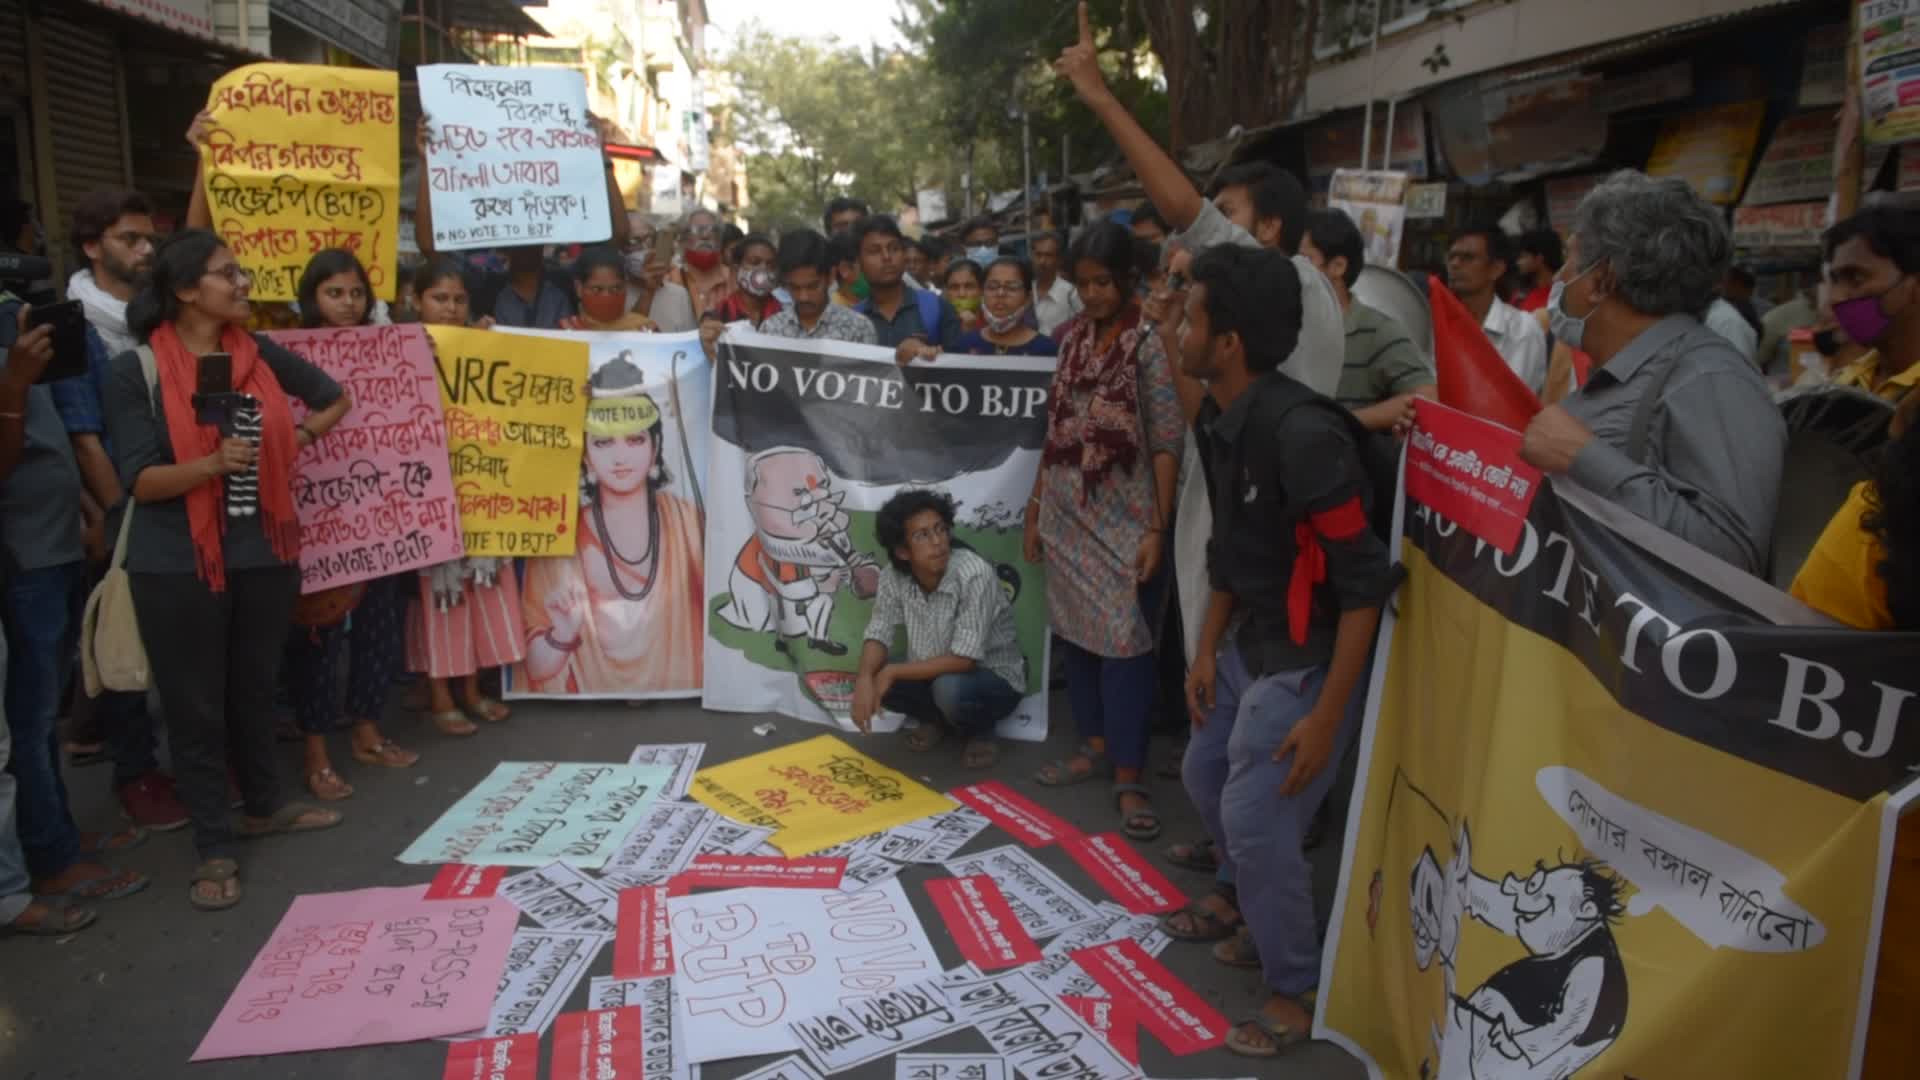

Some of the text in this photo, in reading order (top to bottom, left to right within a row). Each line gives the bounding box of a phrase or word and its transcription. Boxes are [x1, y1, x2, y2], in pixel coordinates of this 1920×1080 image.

[727, 360, 1048, 418] NO VOTE TO BJP
[462, 530, 558, 554] OTE TO BJP
[1473, 515, 1602, 637] OTE
[1616, 593, 1737, 699] TO
[1768, 653, 1920, 770] BJ
[672, 903, 787, 1028] BJP
[822, 889, 926, 1008] NO VO
